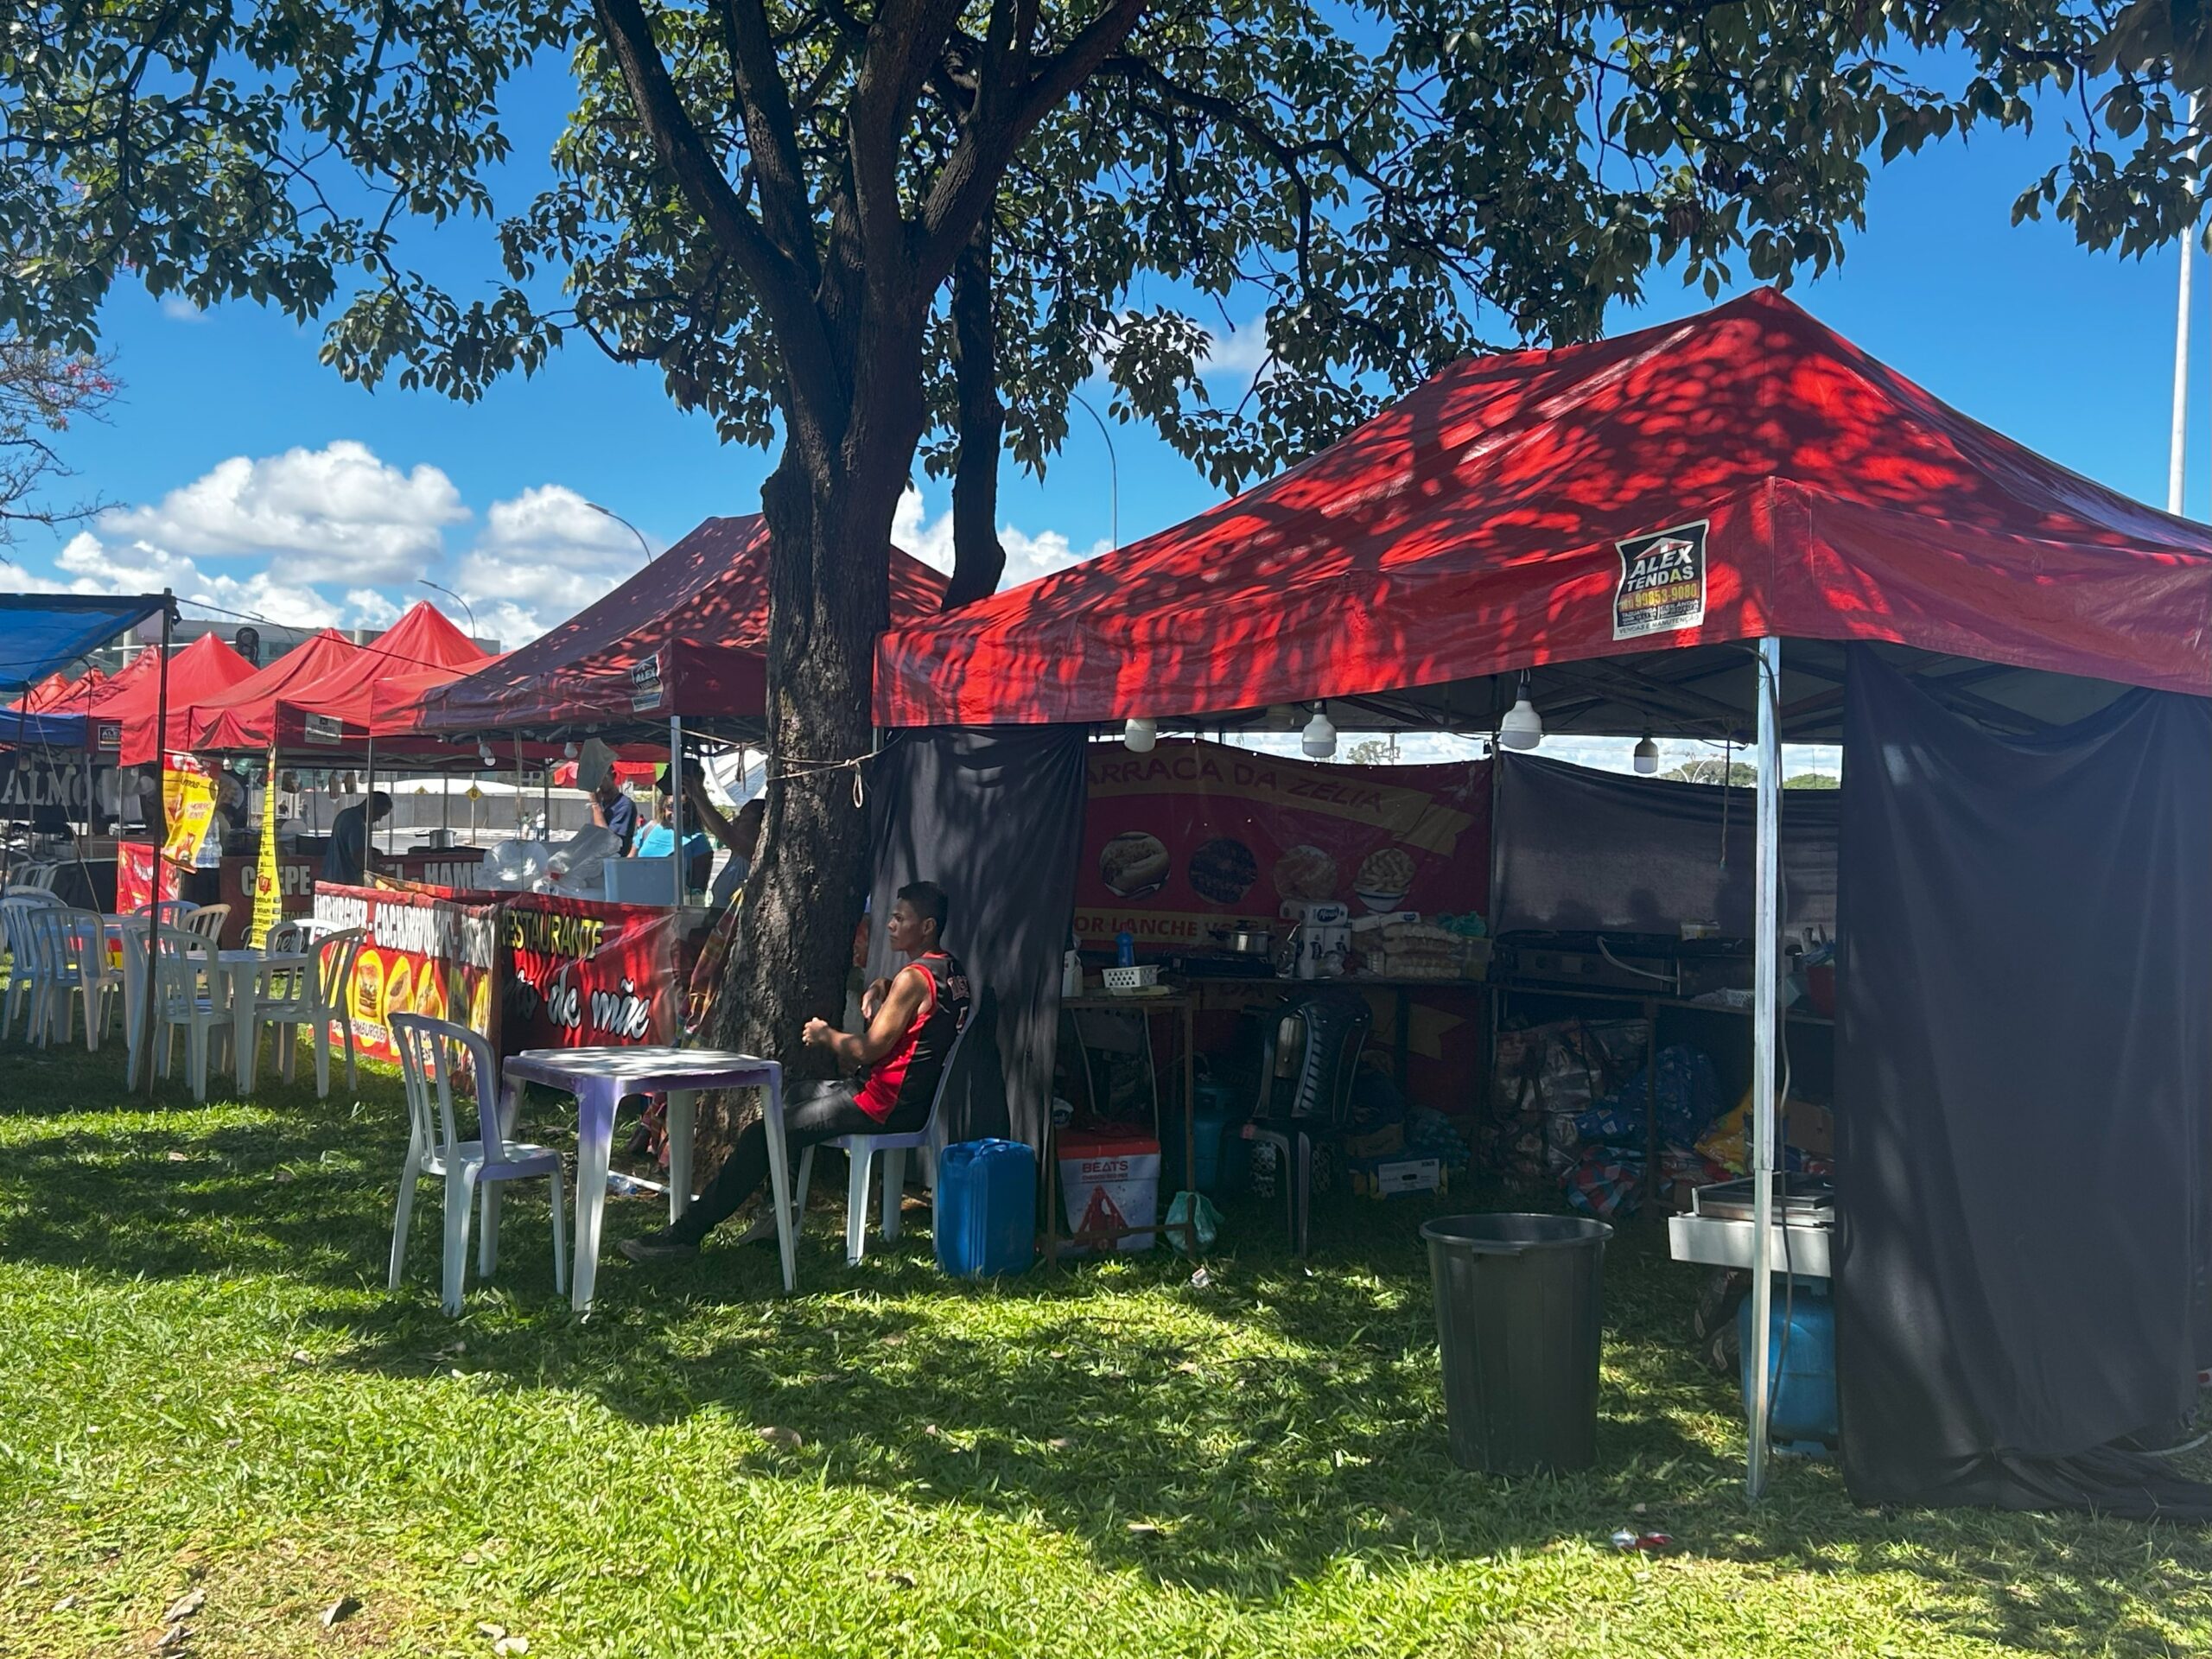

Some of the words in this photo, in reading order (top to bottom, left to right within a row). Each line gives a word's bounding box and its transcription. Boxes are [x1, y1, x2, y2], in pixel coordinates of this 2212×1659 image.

[1629, 544, 1694, 580] ALEX
[1627, 565, 1694, 592] TENDAS
[1111, 918, 1198, 936] LANCHE
[547, 962, 582, 1029] de
[1082, 1161, 1128, 1173] BEATS
